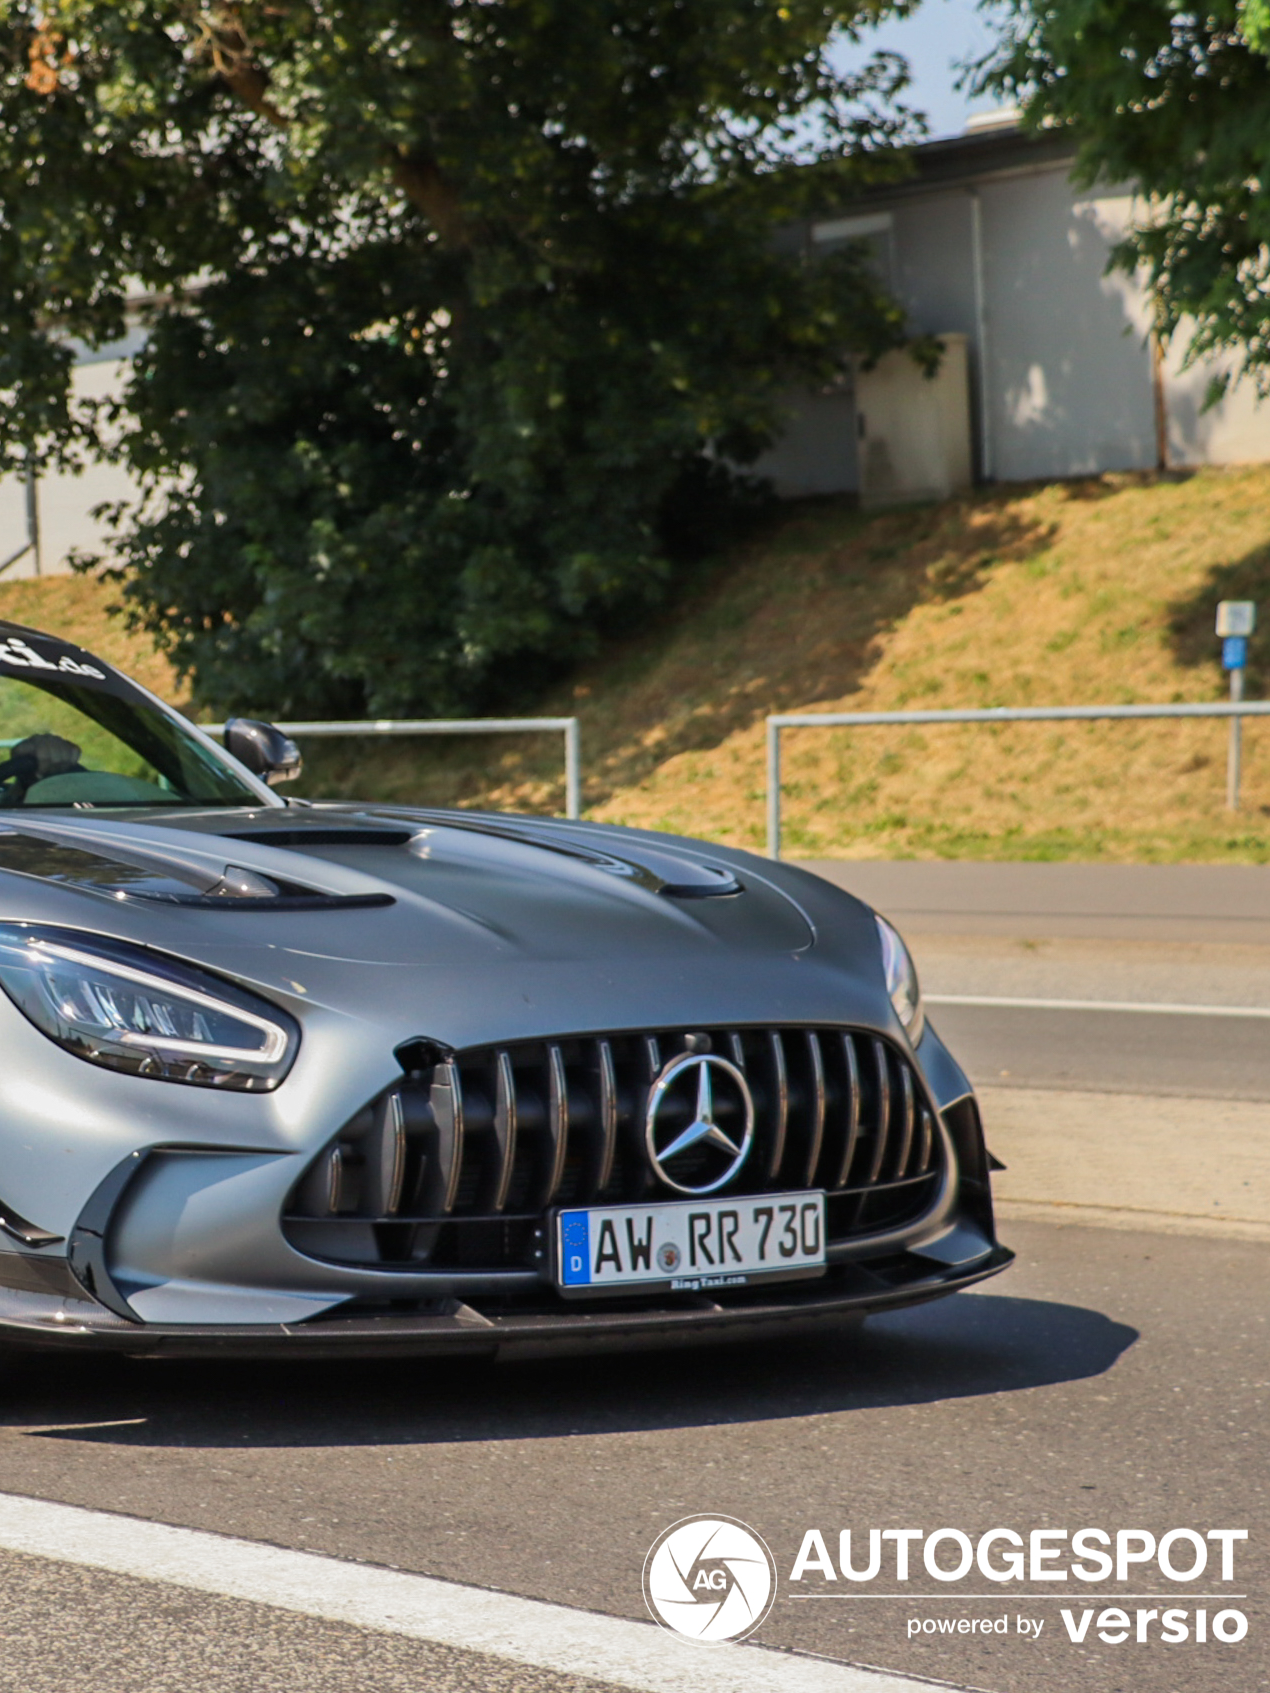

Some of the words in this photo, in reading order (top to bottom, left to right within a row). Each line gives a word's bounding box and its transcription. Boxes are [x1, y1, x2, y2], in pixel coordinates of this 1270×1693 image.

[595, 1217, 653, 1274] AW
[688, 1211, 742, 1266] RR
[753, 1204, 820, 1260] 730
[571, 1256, 582, 1271] D
